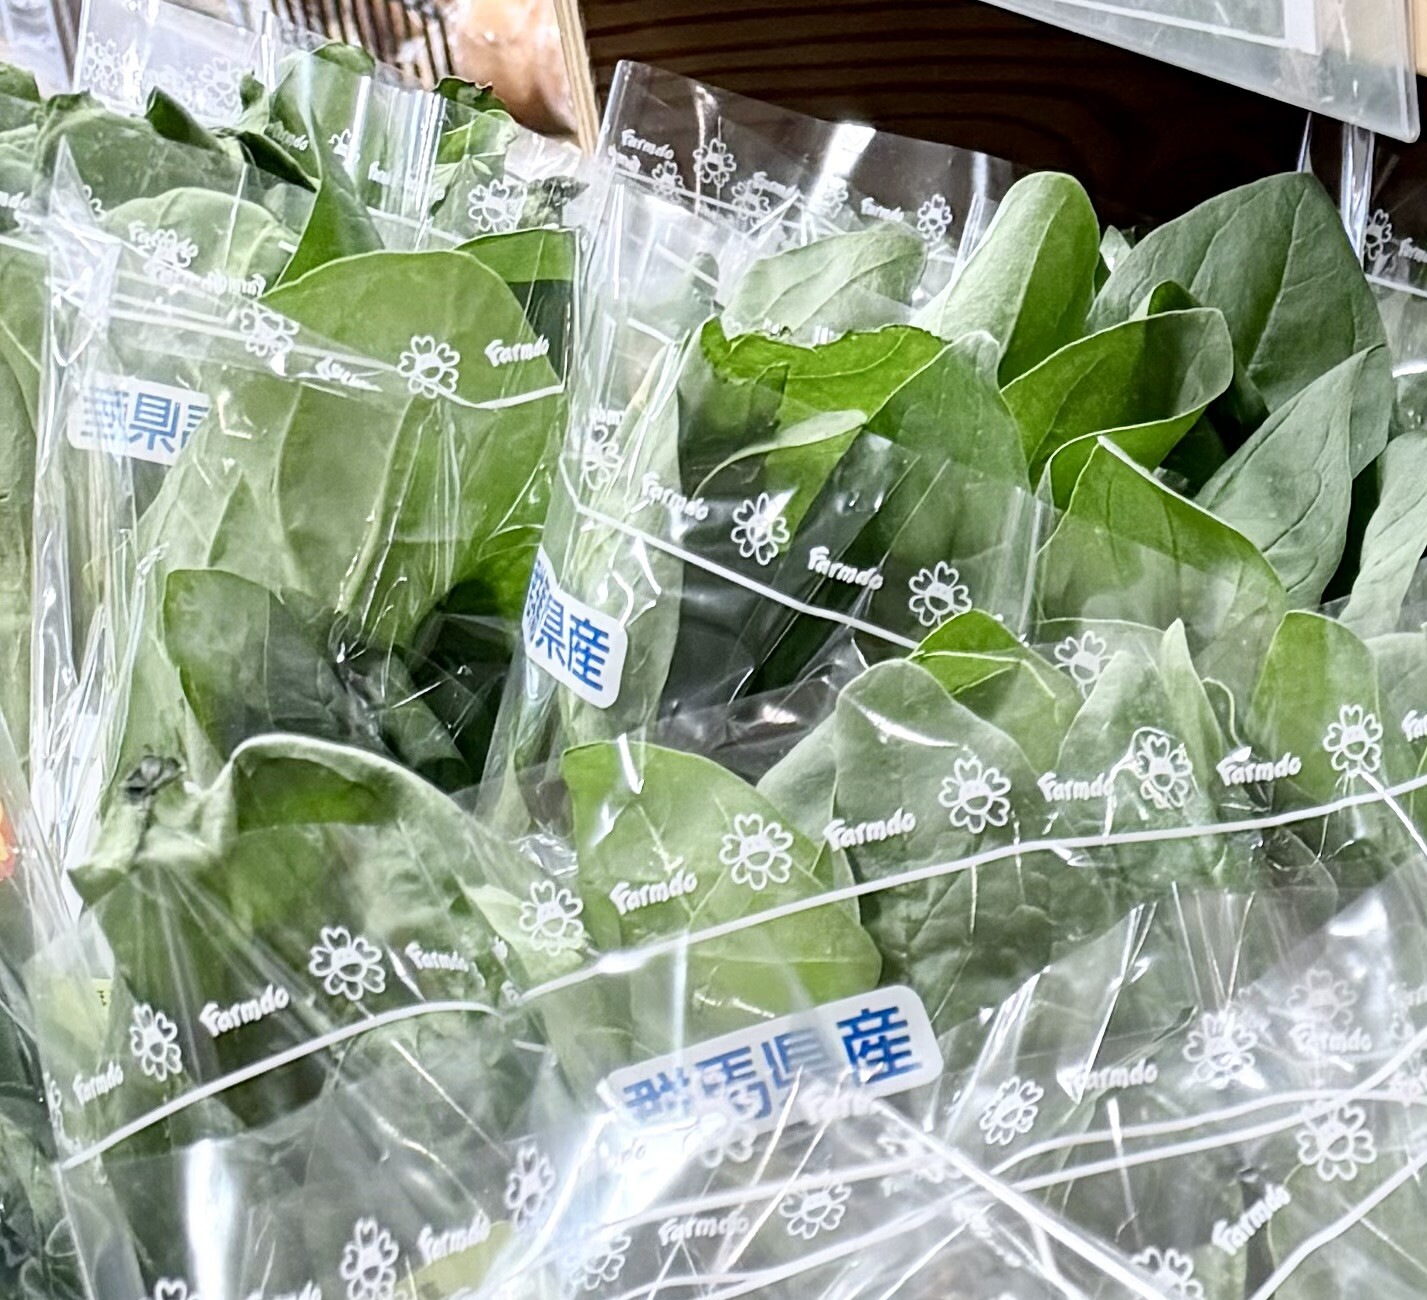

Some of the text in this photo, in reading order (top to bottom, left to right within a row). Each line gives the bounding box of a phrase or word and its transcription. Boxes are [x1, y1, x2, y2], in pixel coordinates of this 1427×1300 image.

[621, 129, 675, 160] Farmdo
[485, 336, 550, 367] Farmdo
[642, 473, 709, 521] Farmdo
[809, 547, 883, 591] Farmdo
[1037, 771, 1115, 802] Farmdo
[1218, 752, 1301, 787] Farmdo
[824, 808, 915, 850] Farmdo
[610, 871, 697, 913] Farmdo
[200, 986, 290, 1040] Farmdo
[623, 1005, 924, 1118] 群馬県産
[72, 1064, 124, 1106] Farmdo
[418, 1215, 490, 1263] Farmdo
[660, 1214, 750, 1248] Farmdo
[1213, 1185, 1293, 1257] Farmdo
